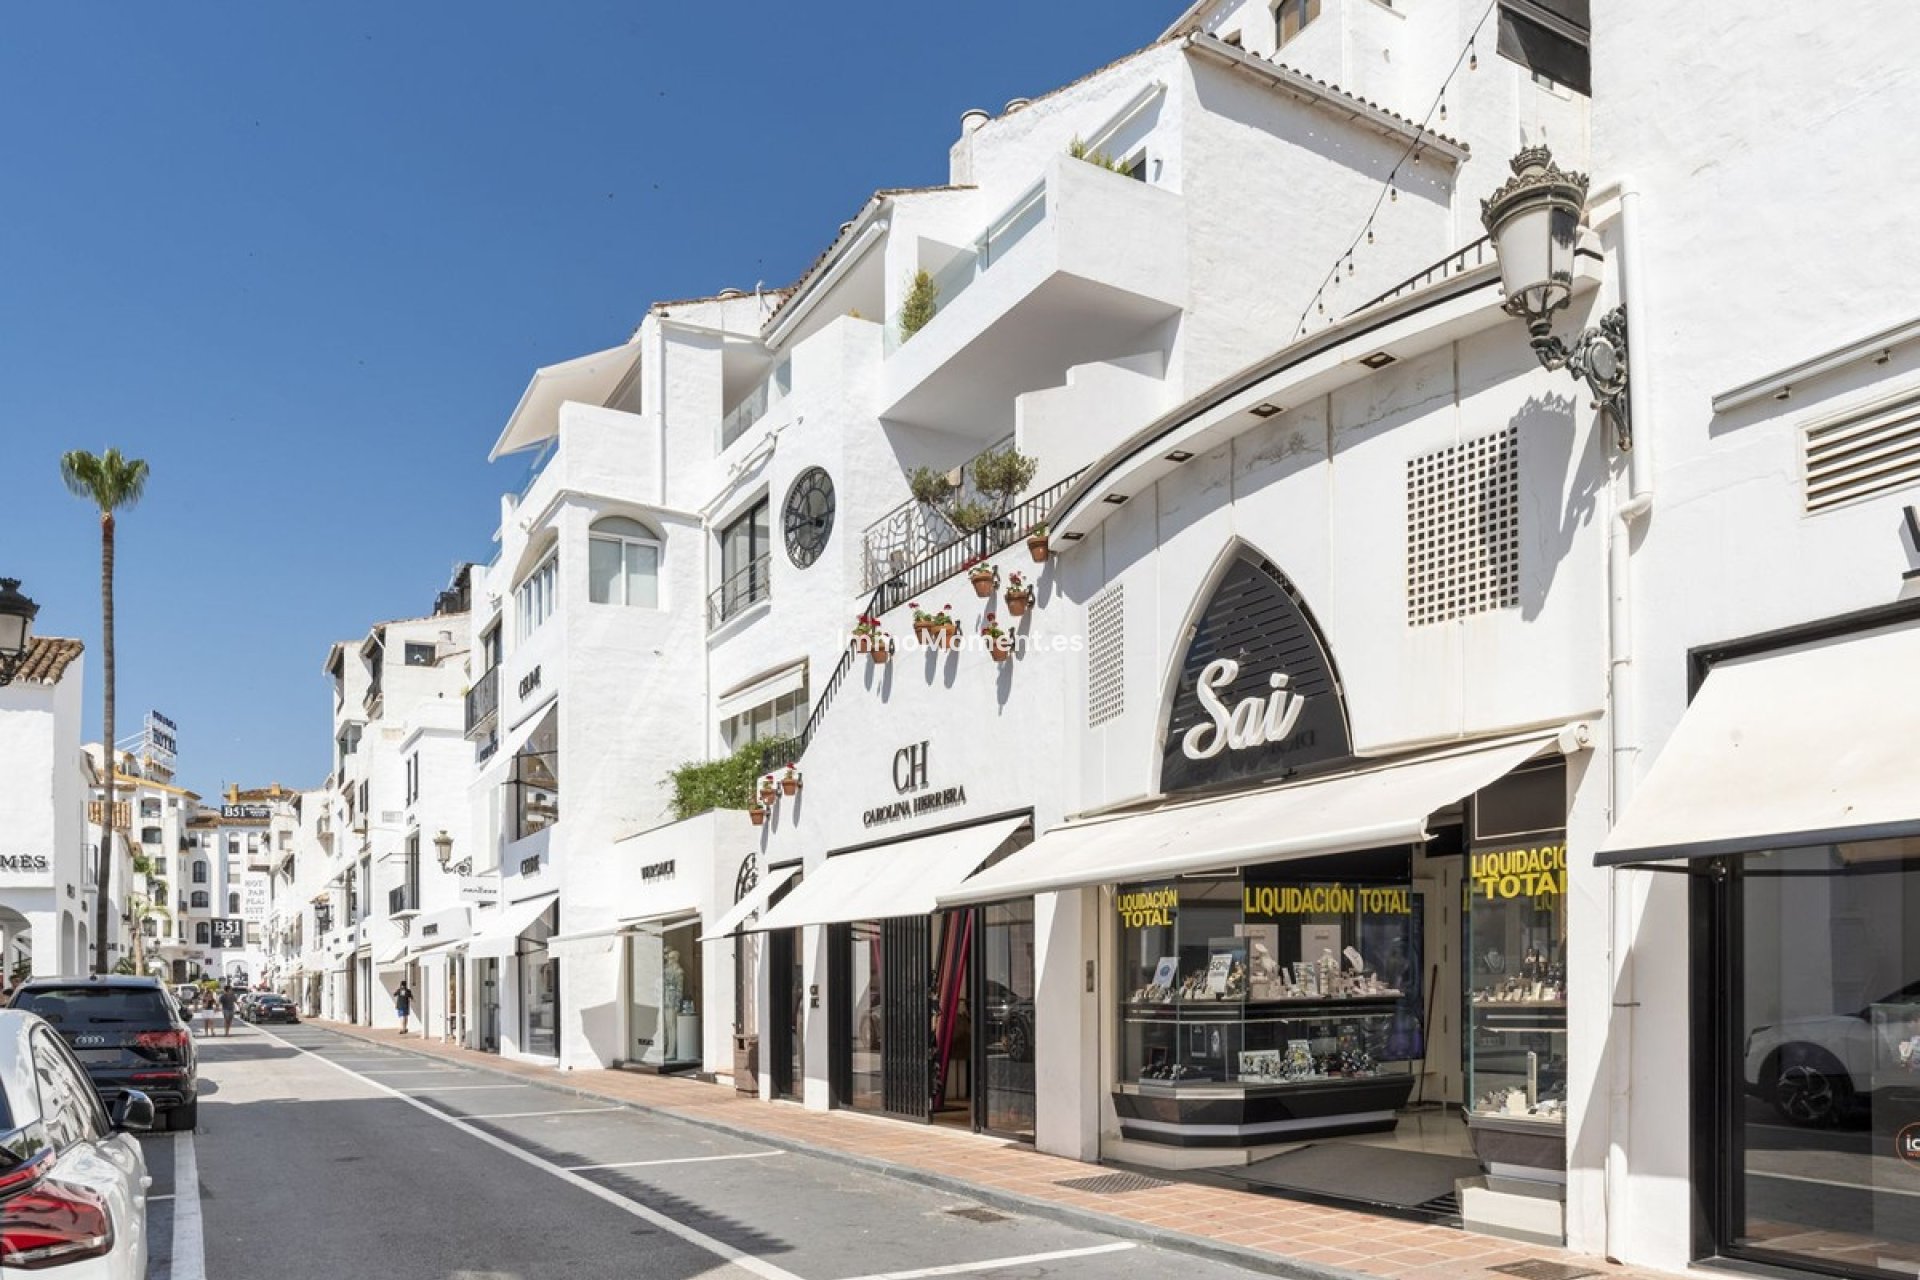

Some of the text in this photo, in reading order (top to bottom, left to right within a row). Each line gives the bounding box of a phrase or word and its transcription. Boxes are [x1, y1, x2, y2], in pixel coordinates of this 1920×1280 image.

[1182, 658, 1305, 760] Sai
[893, 740, 929, 794] CH
[863, 785, 966, 828] CAROLINA HERRERA
[1118, 887, 1177, 912] LIQUIDACIÓN
[1122, 909, 1173, 928] TOTAL
[1244, 883, 1411, 917] LIQUIDACIÓN TOTAL
